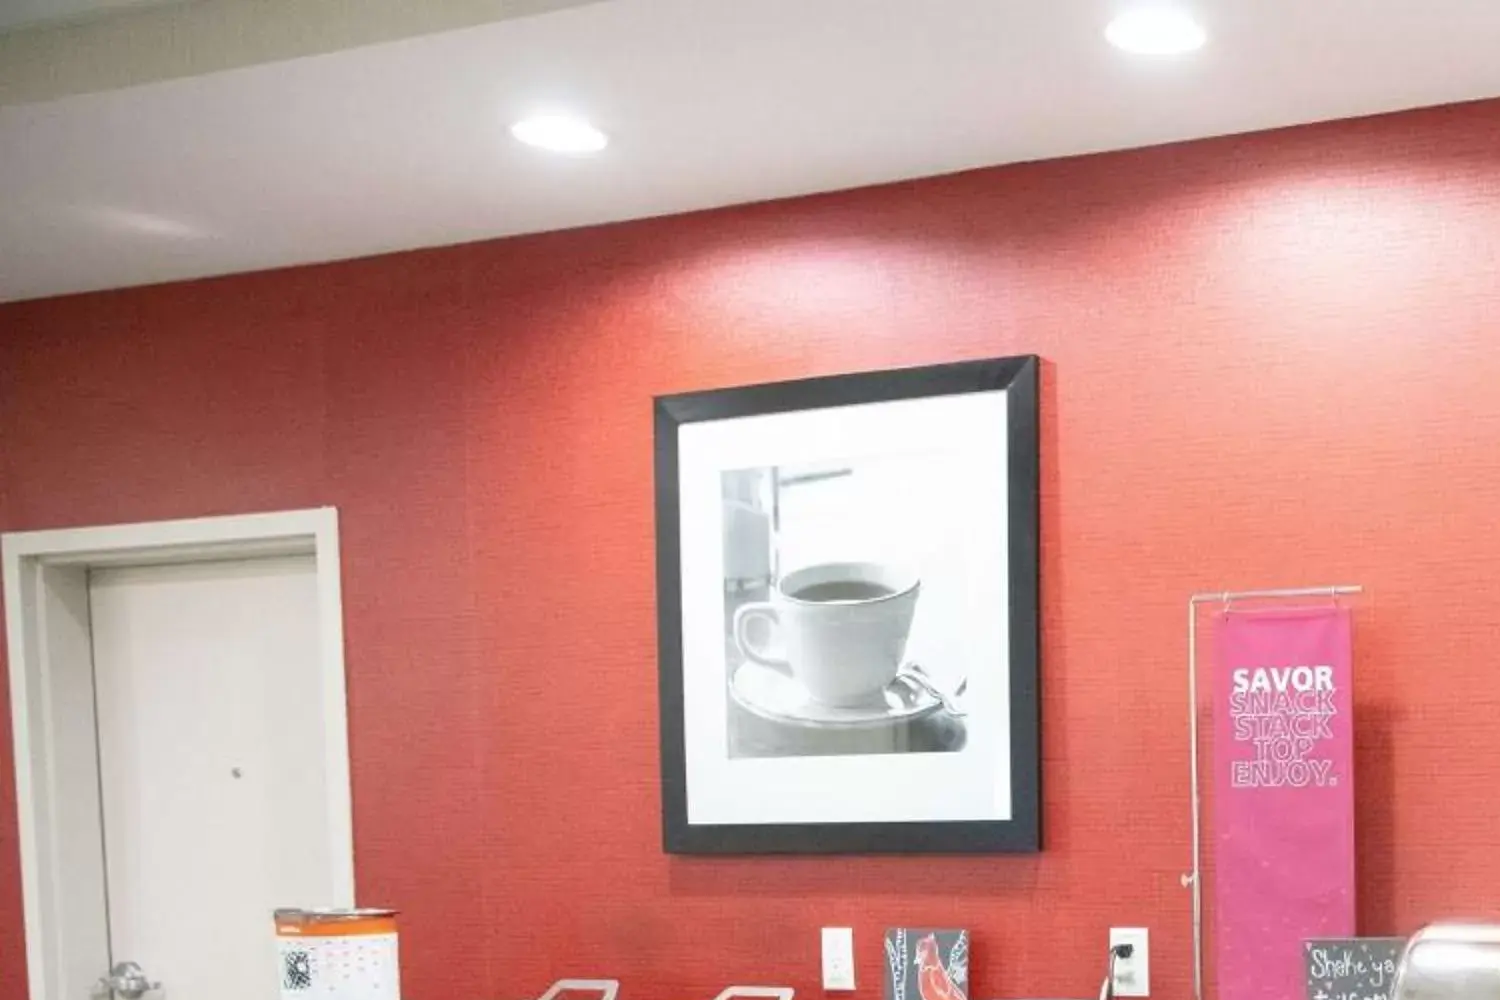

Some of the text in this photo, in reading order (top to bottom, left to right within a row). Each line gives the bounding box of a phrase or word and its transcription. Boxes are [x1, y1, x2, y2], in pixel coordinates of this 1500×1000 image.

[1233, 665, 1333, 692] SAVOR
[1230, 688, 1337, 716] SNACK
[1235, 713, 1334, 740] STACK
[1254, 737, 1313, 762] TOP
[1231, 760, 1338, 787] ENJOY.
